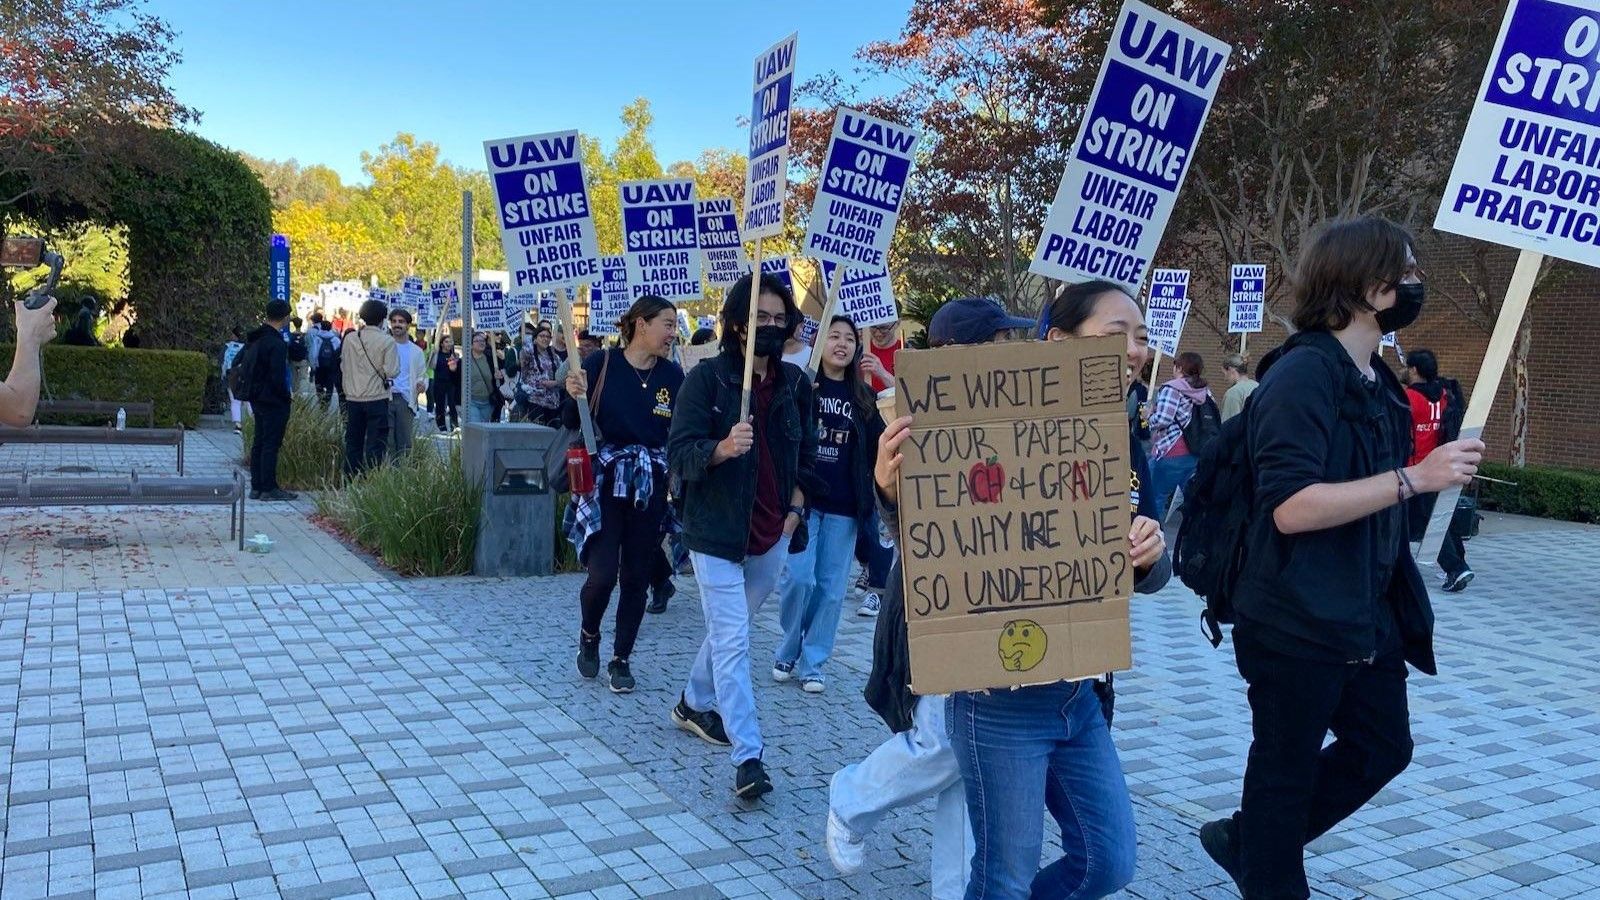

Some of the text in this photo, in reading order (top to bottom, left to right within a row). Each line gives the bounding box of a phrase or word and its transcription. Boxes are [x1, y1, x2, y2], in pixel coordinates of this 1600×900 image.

[1119, 11, 1224, 90] UAW
[1564, 15, 1600, 64] O
[757, 40, 794, 85] UAW
[762, 83, 779, 116] ON
[1131, 84, 1176, 131] ON
[750, 110, 787, 152] STRIKE
[842, 114, 916, 153] UAW
[1499, 117, 1600, 169] UNFAI
[490, 135, 575, 168] UAW
[1085, 116, 1185, 182] STRIKE
[752, 155, 779, 183] UNFAIR
[855, 154, 886, 176] ON
[524, 169, 557, 195] ON
[623, 182, 692, 204] UAW
[751, 180, 776, 206] LABOR
[827, 166, 900, 206] STRIKE
[1491, 154, 1600, 208] LABOR
[1080, 171, 1158, 220] UNFAIR
[504, 192, 586, 224] STRIKE
[646, 207, 674, 228] ON
[744, 202, 780, 231] PRACTICE
[829, 200, 883, 229] UNFAIR
[1452, 183, 1600, 247] PRACTIC
[518, 223, 582, 247] UNFAIR
[707, 216, 724, 231] ON
[827, 219, 876, 245] LABOR
[1071, 206, 1143, 250] LABOR
[628, 227, 696, 248] STRIKE
[700, 230, 739, 246] STRIKE
[810, 233, 882, 266] PRACTICE
[526, 241, 583, 266] LABOR
[638, 251, 689, 267] UNFAIR
[707, 250, 738, 261] UNFAIR
[711, 260, 738, 271] LABOR
[748, 258, 786, 273] AW
[1043, 233, 1147, 284] PRACTICE
[516, 257, 599, 286] PRACTICE
[612, 270, 625, 280] ON
[643, 267, 688, 282] LABOR
[1154, 271, 1188, 283] UAW
[1233, 267, 1264, 277] UAW
[472, 282, 500, 290] UAW
[481, 292, 493, 300] ON
[633, 280, 700, 298] PRACTICE
[838, 281, 881, 300] UNFAIR
[1160, 286, 1175, 297] ON
[1233, 291, 1263, 302] STRIKE
[1242, 280, 1255, 291] ON
[474, 299, 503, 309] STRIKE
[842, 294, 881, 313] LABOR
[1150, 296, 1182, 309] STRIKE
[1235, 304, 1258, 312] UNFAIR
[476, 322, 505, 330] PRACTICE
[1151, 311, 1176, 320] UNFAIR
[1151, 320, 1174, 328] LABOR
[1230, 320, 1261, 329] PRACTICE
[1236, 312, 1257, 320] LABOR
[899, 366, 1060, 414] WE WRITE
[909, 418, 1109, 464] YOUR PAPERS,
[905, 466, 1003, 510] TEACH
[1039, 457, 1125, 502] GRADE
[910, 506, 1123, 559] SO WHY ARE WE
[913, 551, 1126, 616] SO UNDERPAID?
